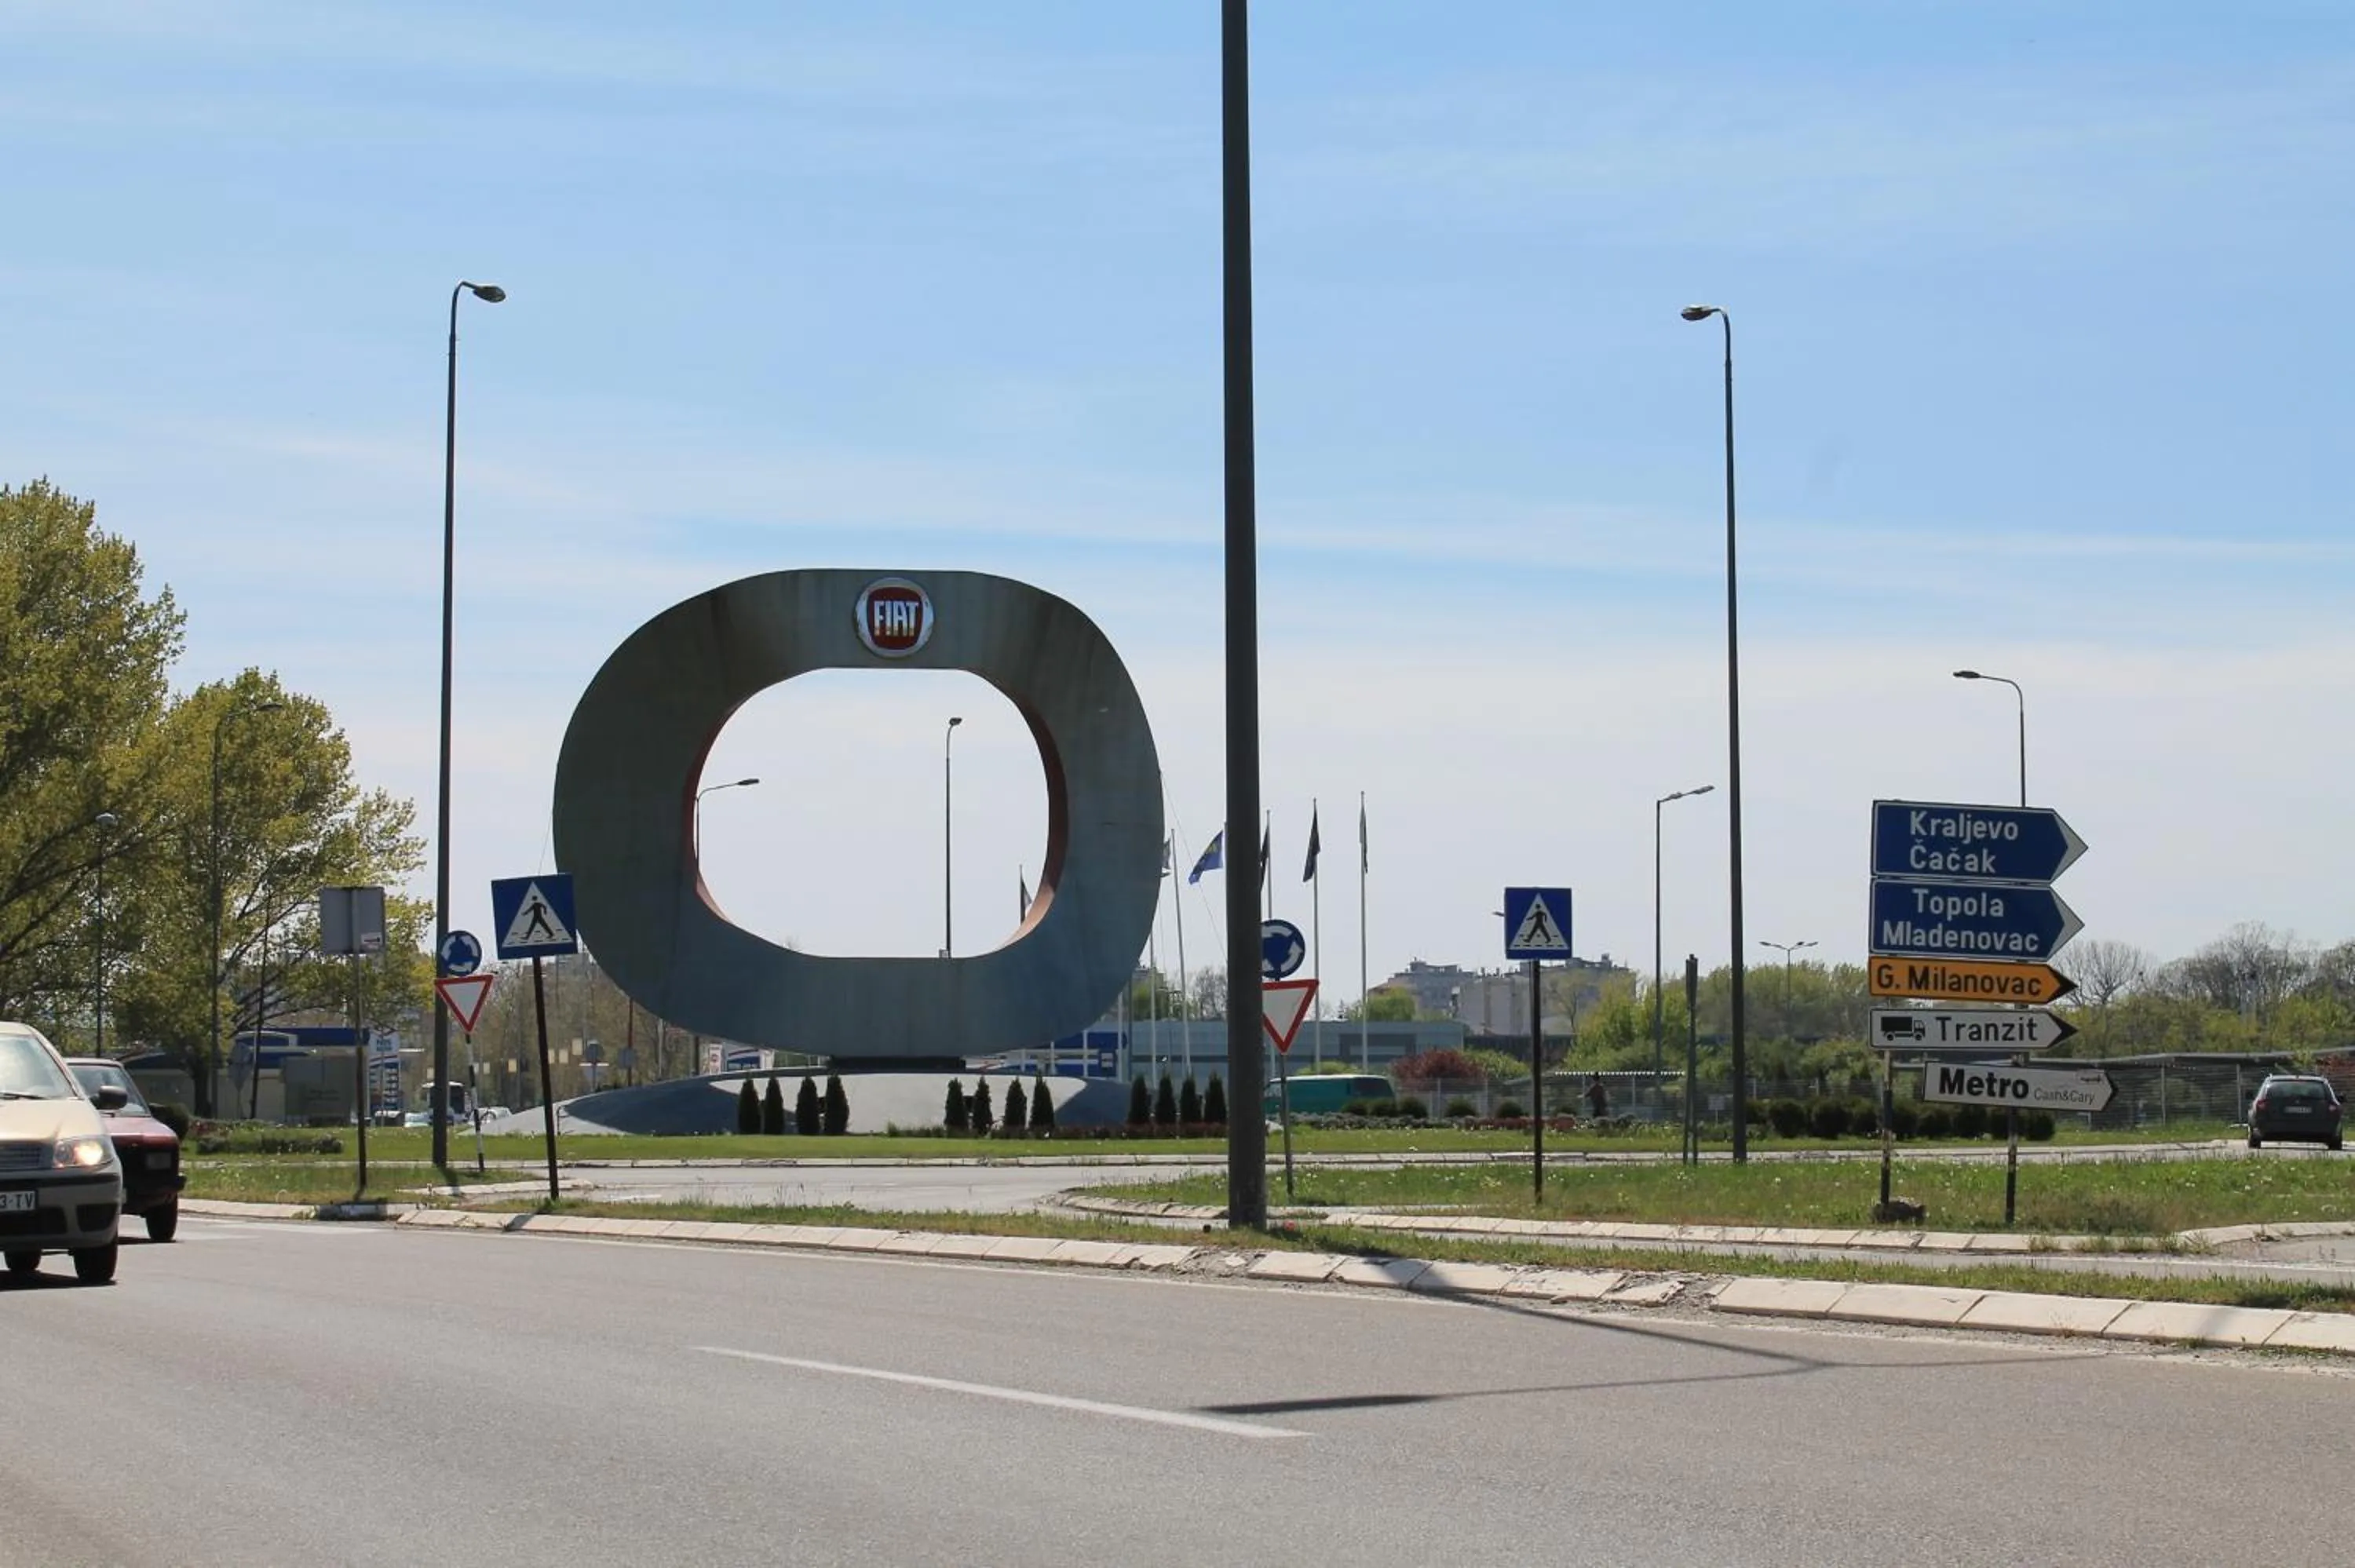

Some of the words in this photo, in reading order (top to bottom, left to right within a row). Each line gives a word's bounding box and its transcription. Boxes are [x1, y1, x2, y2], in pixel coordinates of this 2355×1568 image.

[874, 600, 918, 636] FIAT
[1910, 811, 2019, 844] Kraljevo
[1910, 839, 1996, 873] Čačak
[1912, 888, 2004, 921] Topola
[1883, 921, 2039, 953] Mladenovac
[1877, 965, 1900, 989] G.
[1908, 966, 2041, 996] Milanovac
[1936, 1016, 2039, 1041] Tranzit
[1939, 1067, 2030, 1100] Metro
